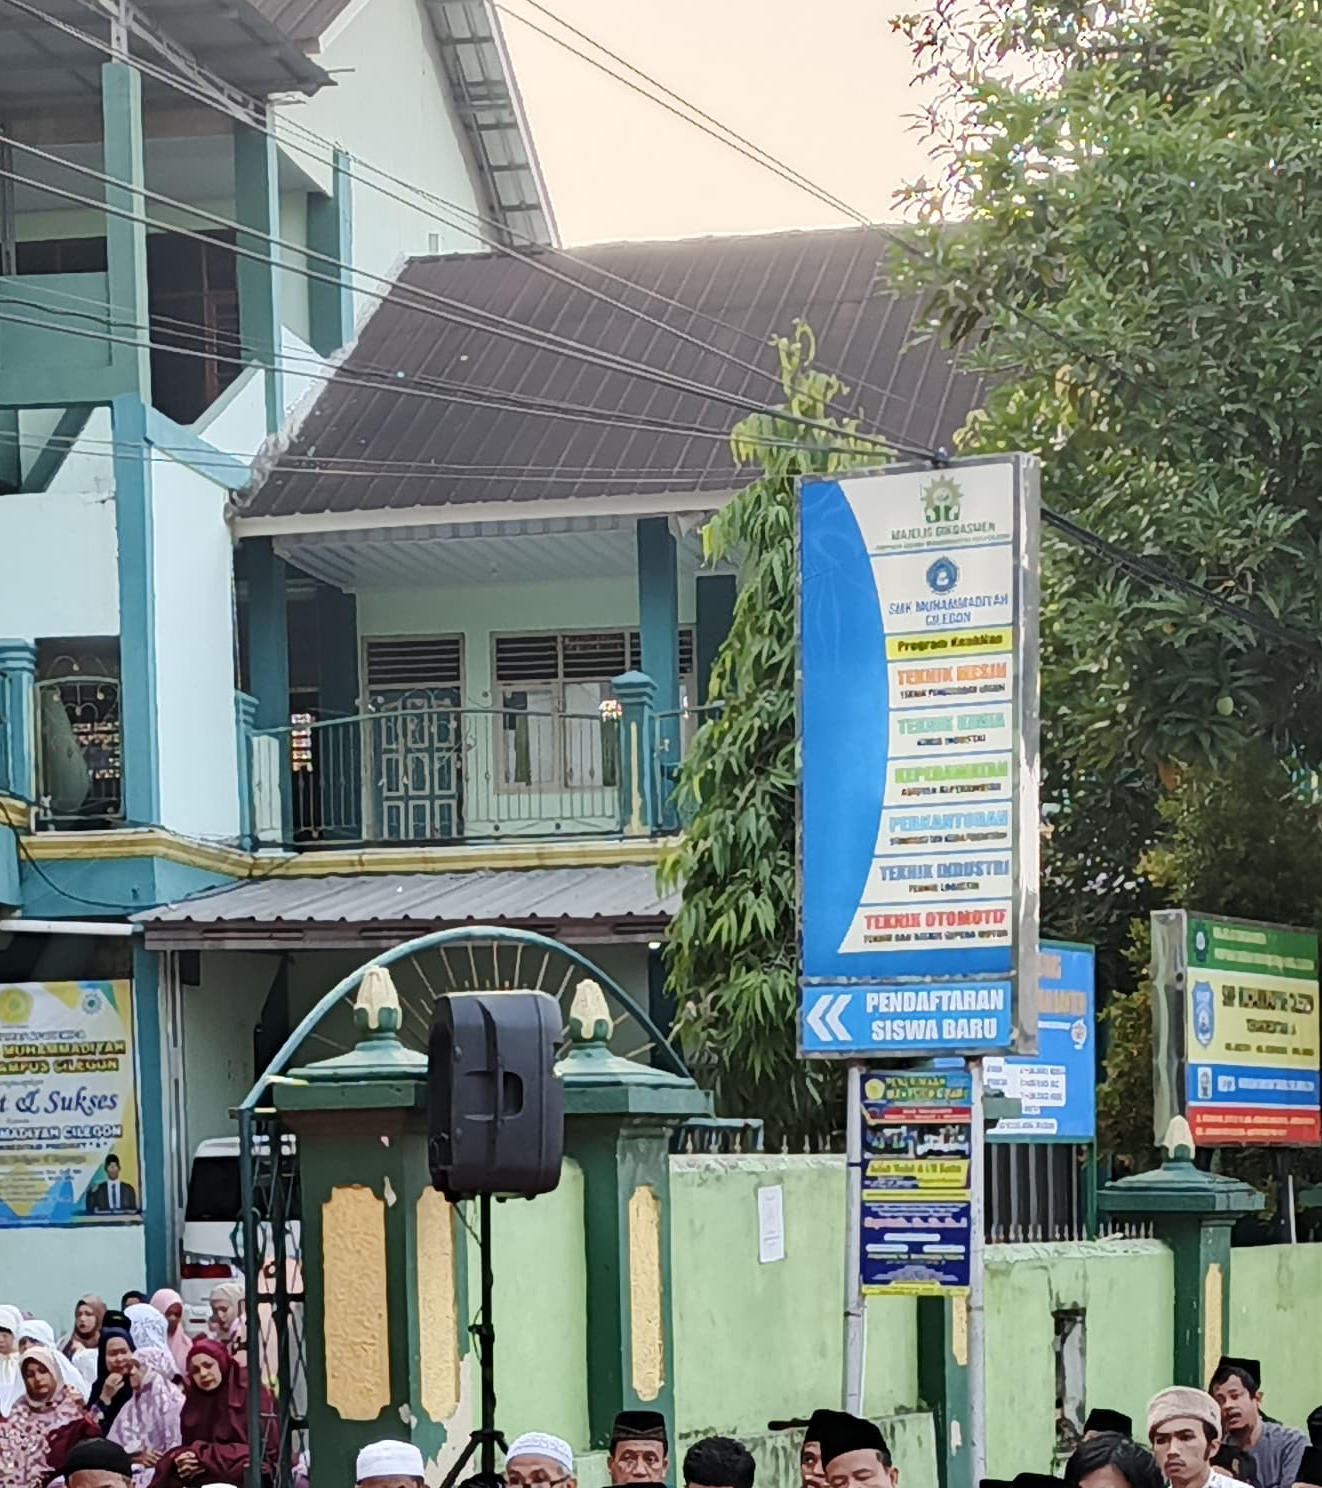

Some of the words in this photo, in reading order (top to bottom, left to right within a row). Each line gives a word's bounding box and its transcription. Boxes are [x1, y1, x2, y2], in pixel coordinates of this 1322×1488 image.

[898, 639, 948, 652] Program
[898, 667, 954, 685] TEKNIK
[898, 716, 953, 735] TEKNIK
[880, 864, 933, 881] TEKNIK
[937, 860, 1009, 877] INDUSTRI
[864, 912, 921, 929] TEKNIK
[926, 909, 1007, 927] OTOMOTIF
[866, 989, 1003, 1013] PENDAFTARAN
[872, 1020, 938, 1041] SISWA
[943, 1018, 997, 1040] BARU
[4, 1041, 126, 1058] MUHAMMADIYAH
[54, 1058, 119, 1073] CILEGON
[45, 1086, 118, 1116] Sukses
[64, 1125, 122, 1139] CILEGON
